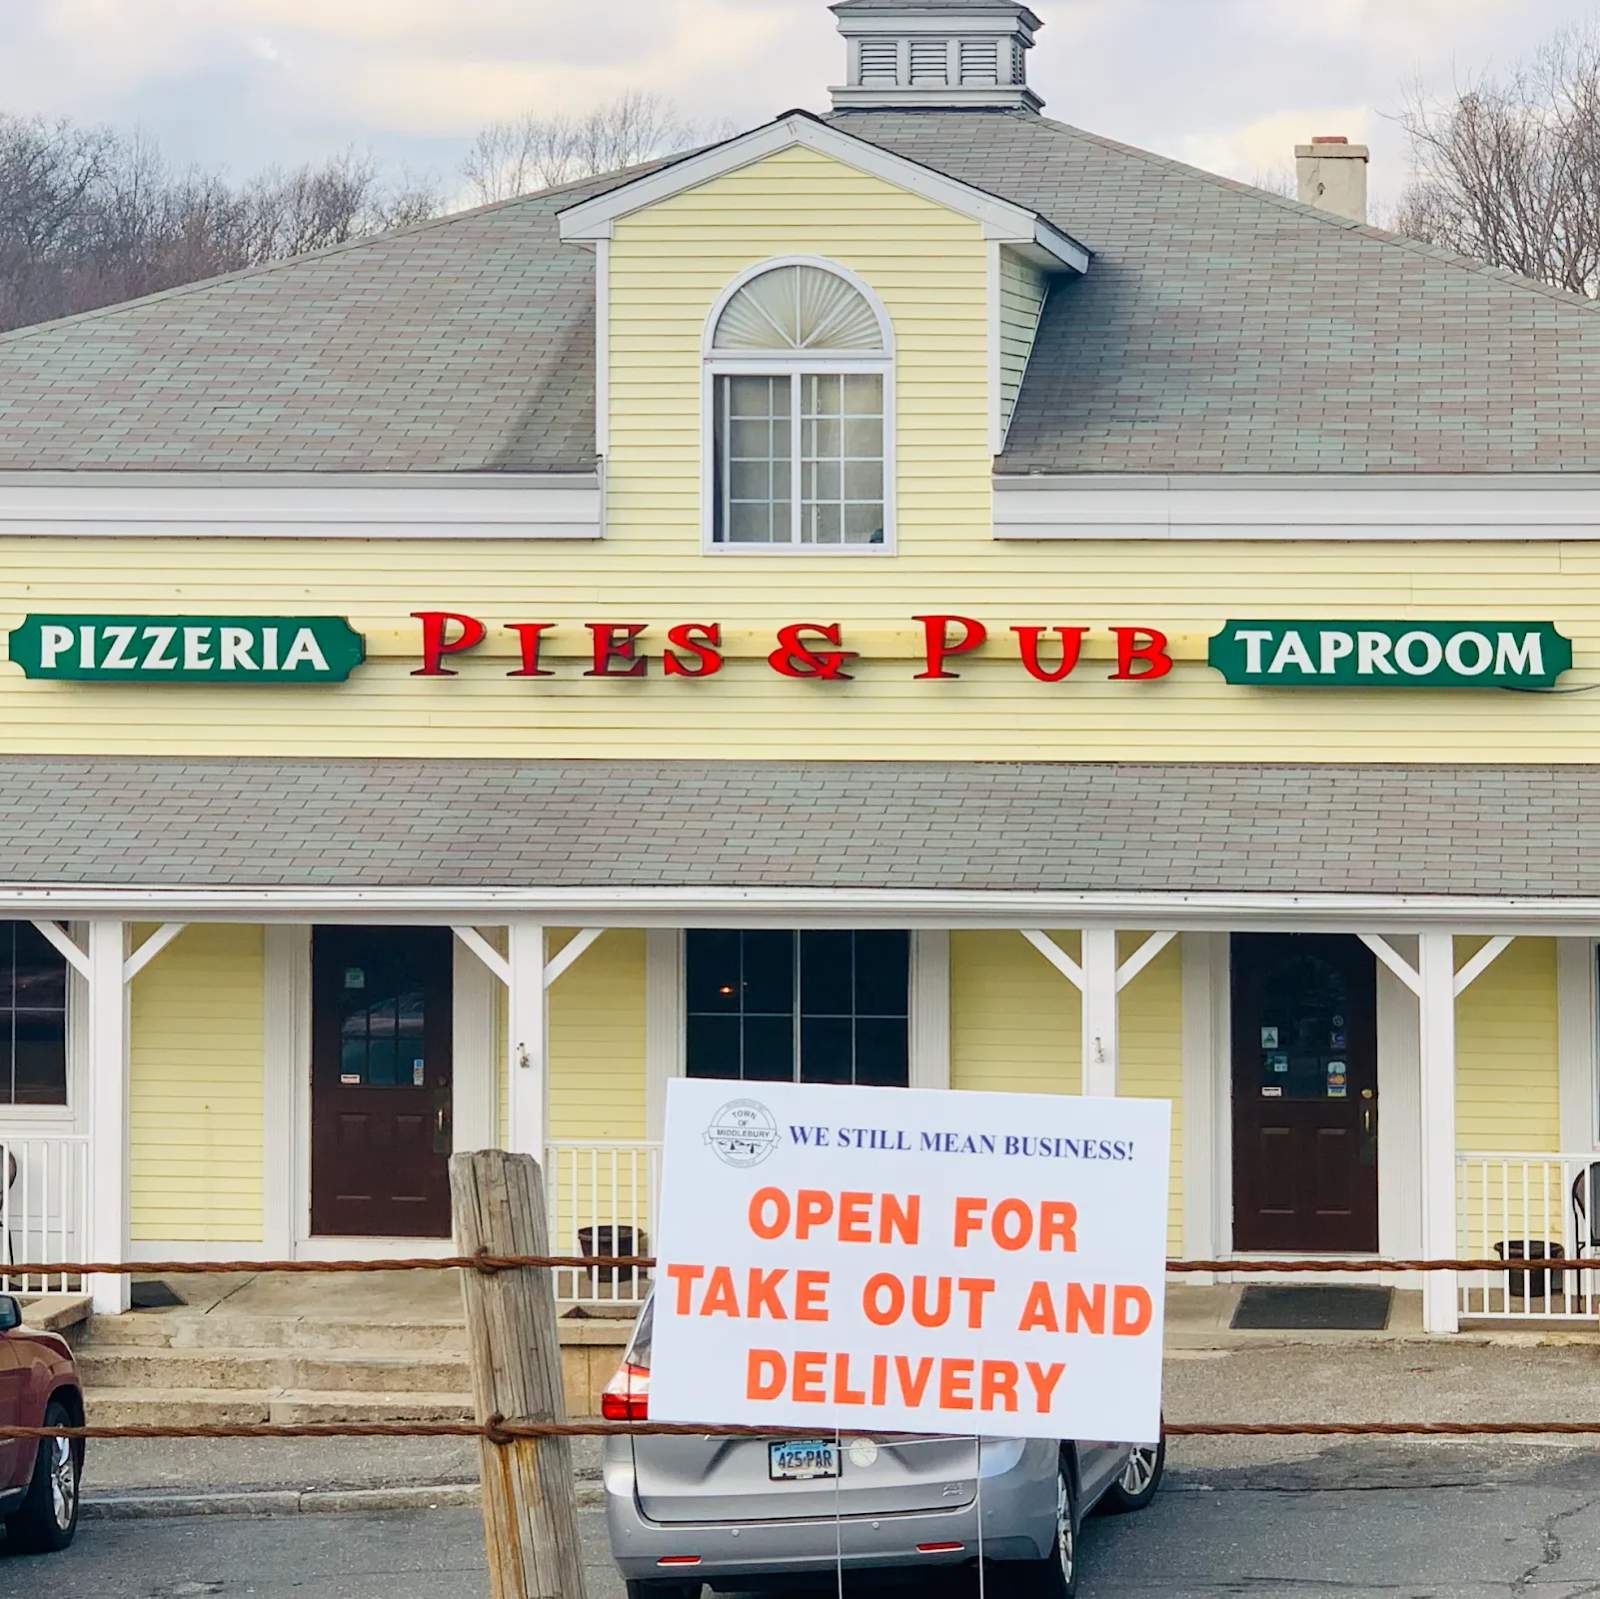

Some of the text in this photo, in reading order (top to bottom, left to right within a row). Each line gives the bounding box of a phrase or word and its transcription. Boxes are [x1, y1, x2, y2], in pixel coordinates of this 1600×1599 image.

[39, 624, 330, 672] PIZZERIA
[410, 611, 1175, 683] PIES & PUB
[1233, 629, 1546, 676] TAPROOM
[716, 1128, 770, 1138] MIDDLEBURY
[731, 1109, 757, 1120] TOWN
[737, 1119, 748, 1127] OF
[788, 1125, 1135, 1162] WE STILL MEAN BUSINESS!
[747, 1186, 1079, 1253] OPEN FOR
[666, 1263, 1154, 1337] TAKE OUT AND
[745, 1348, 1067, 1415] DELIVERY
